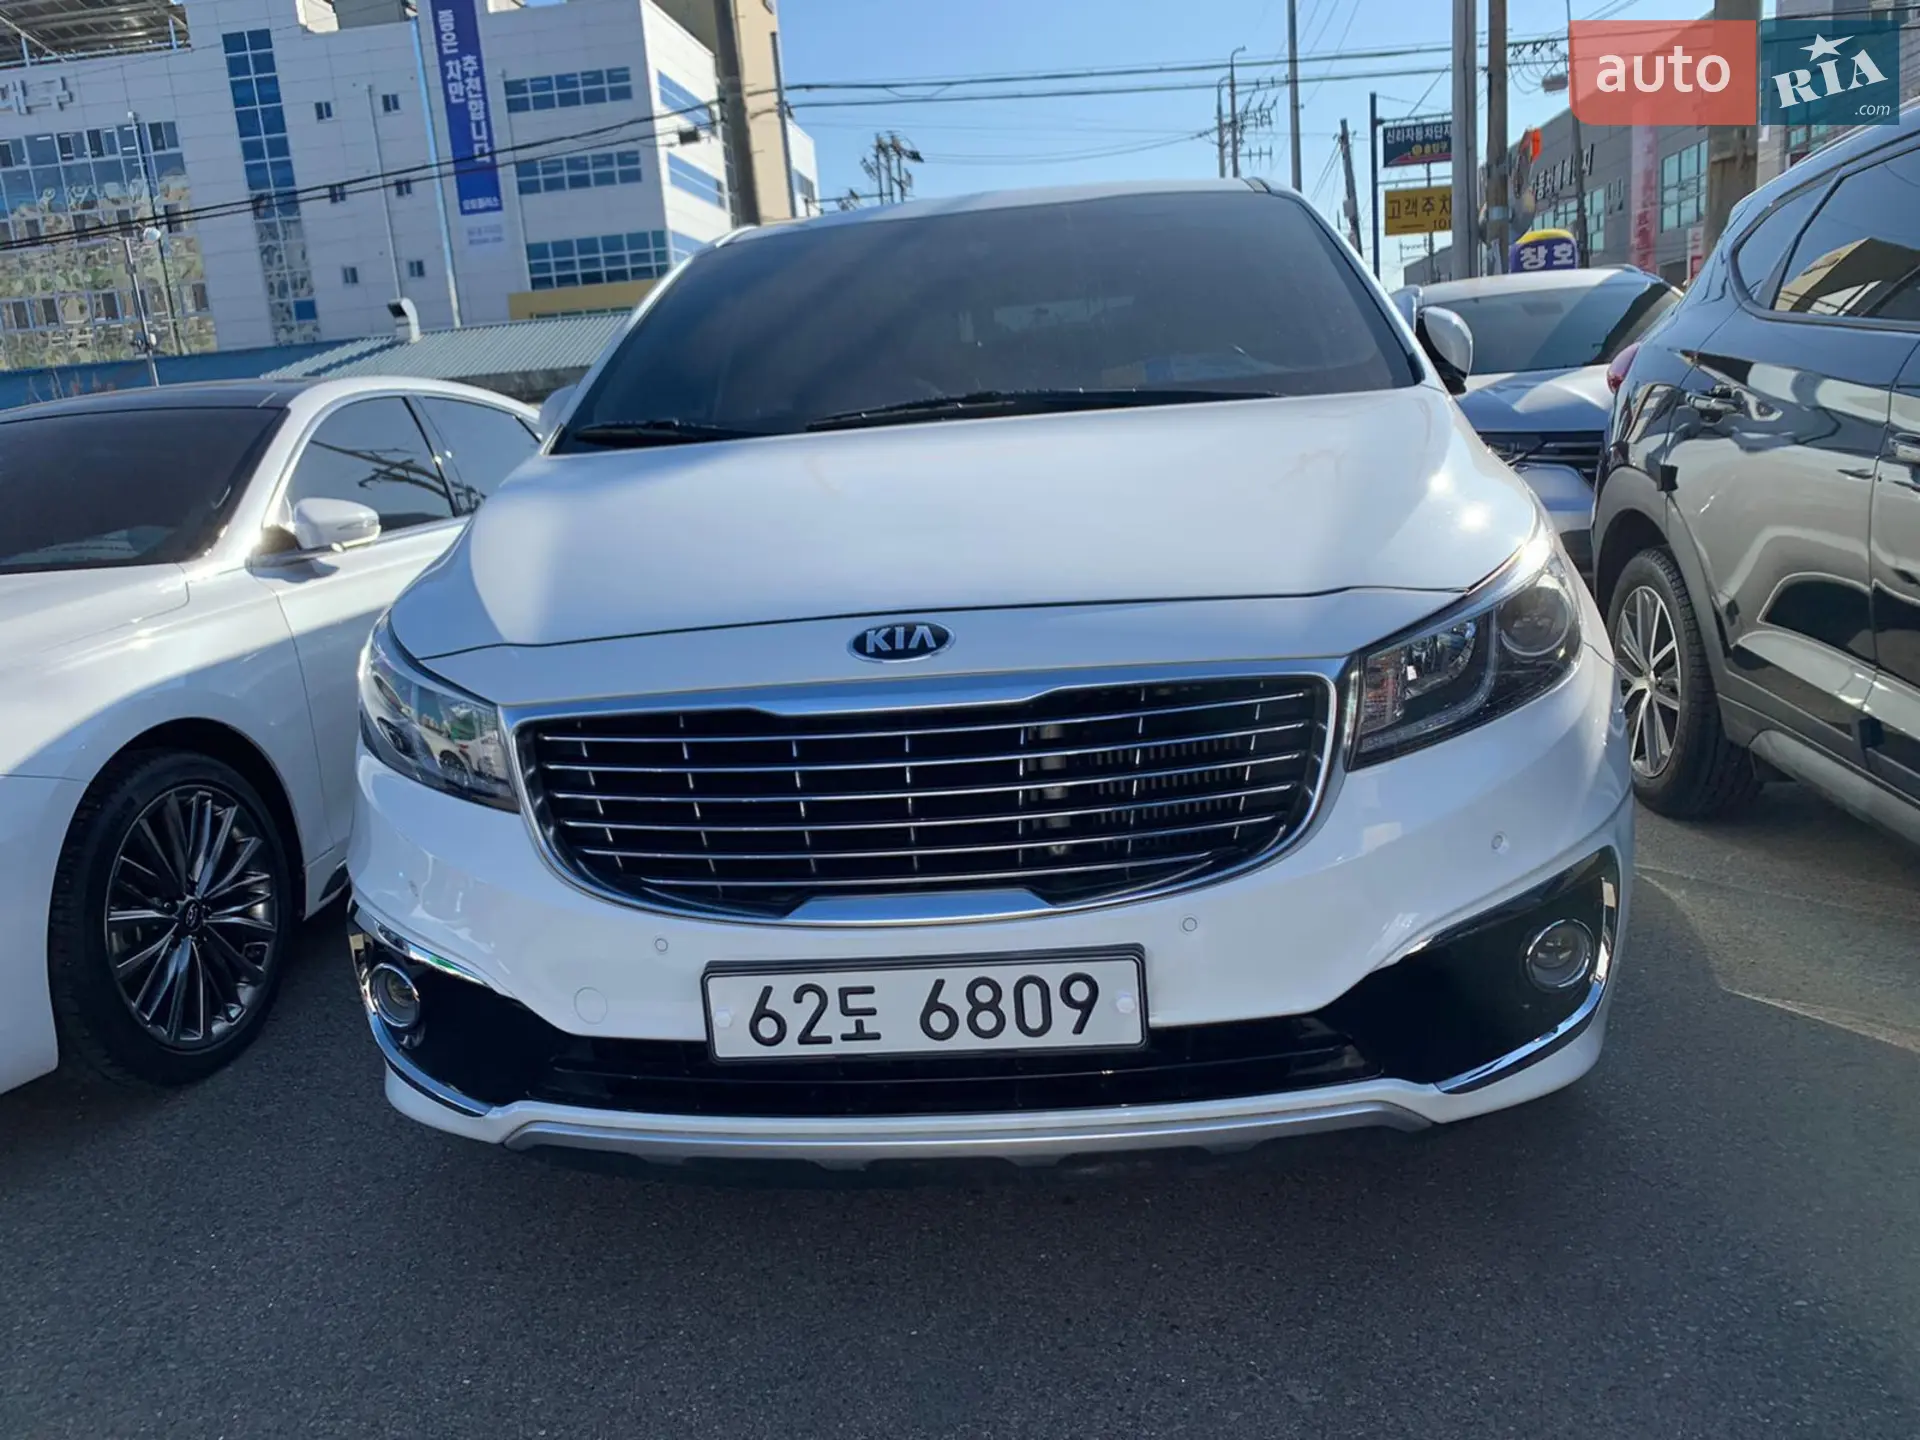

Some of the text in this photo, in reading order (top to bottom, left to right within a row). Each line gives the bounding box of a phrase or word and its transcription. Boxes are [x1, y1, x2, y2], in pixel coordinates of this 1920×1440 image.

[438, 9, 466, 104] 좋은 차만
[461, 54, 491, 163] 추천합니다
[866, 625, 937, 653] KIA
[749, 971, 1100, 1047] 62도 6809
